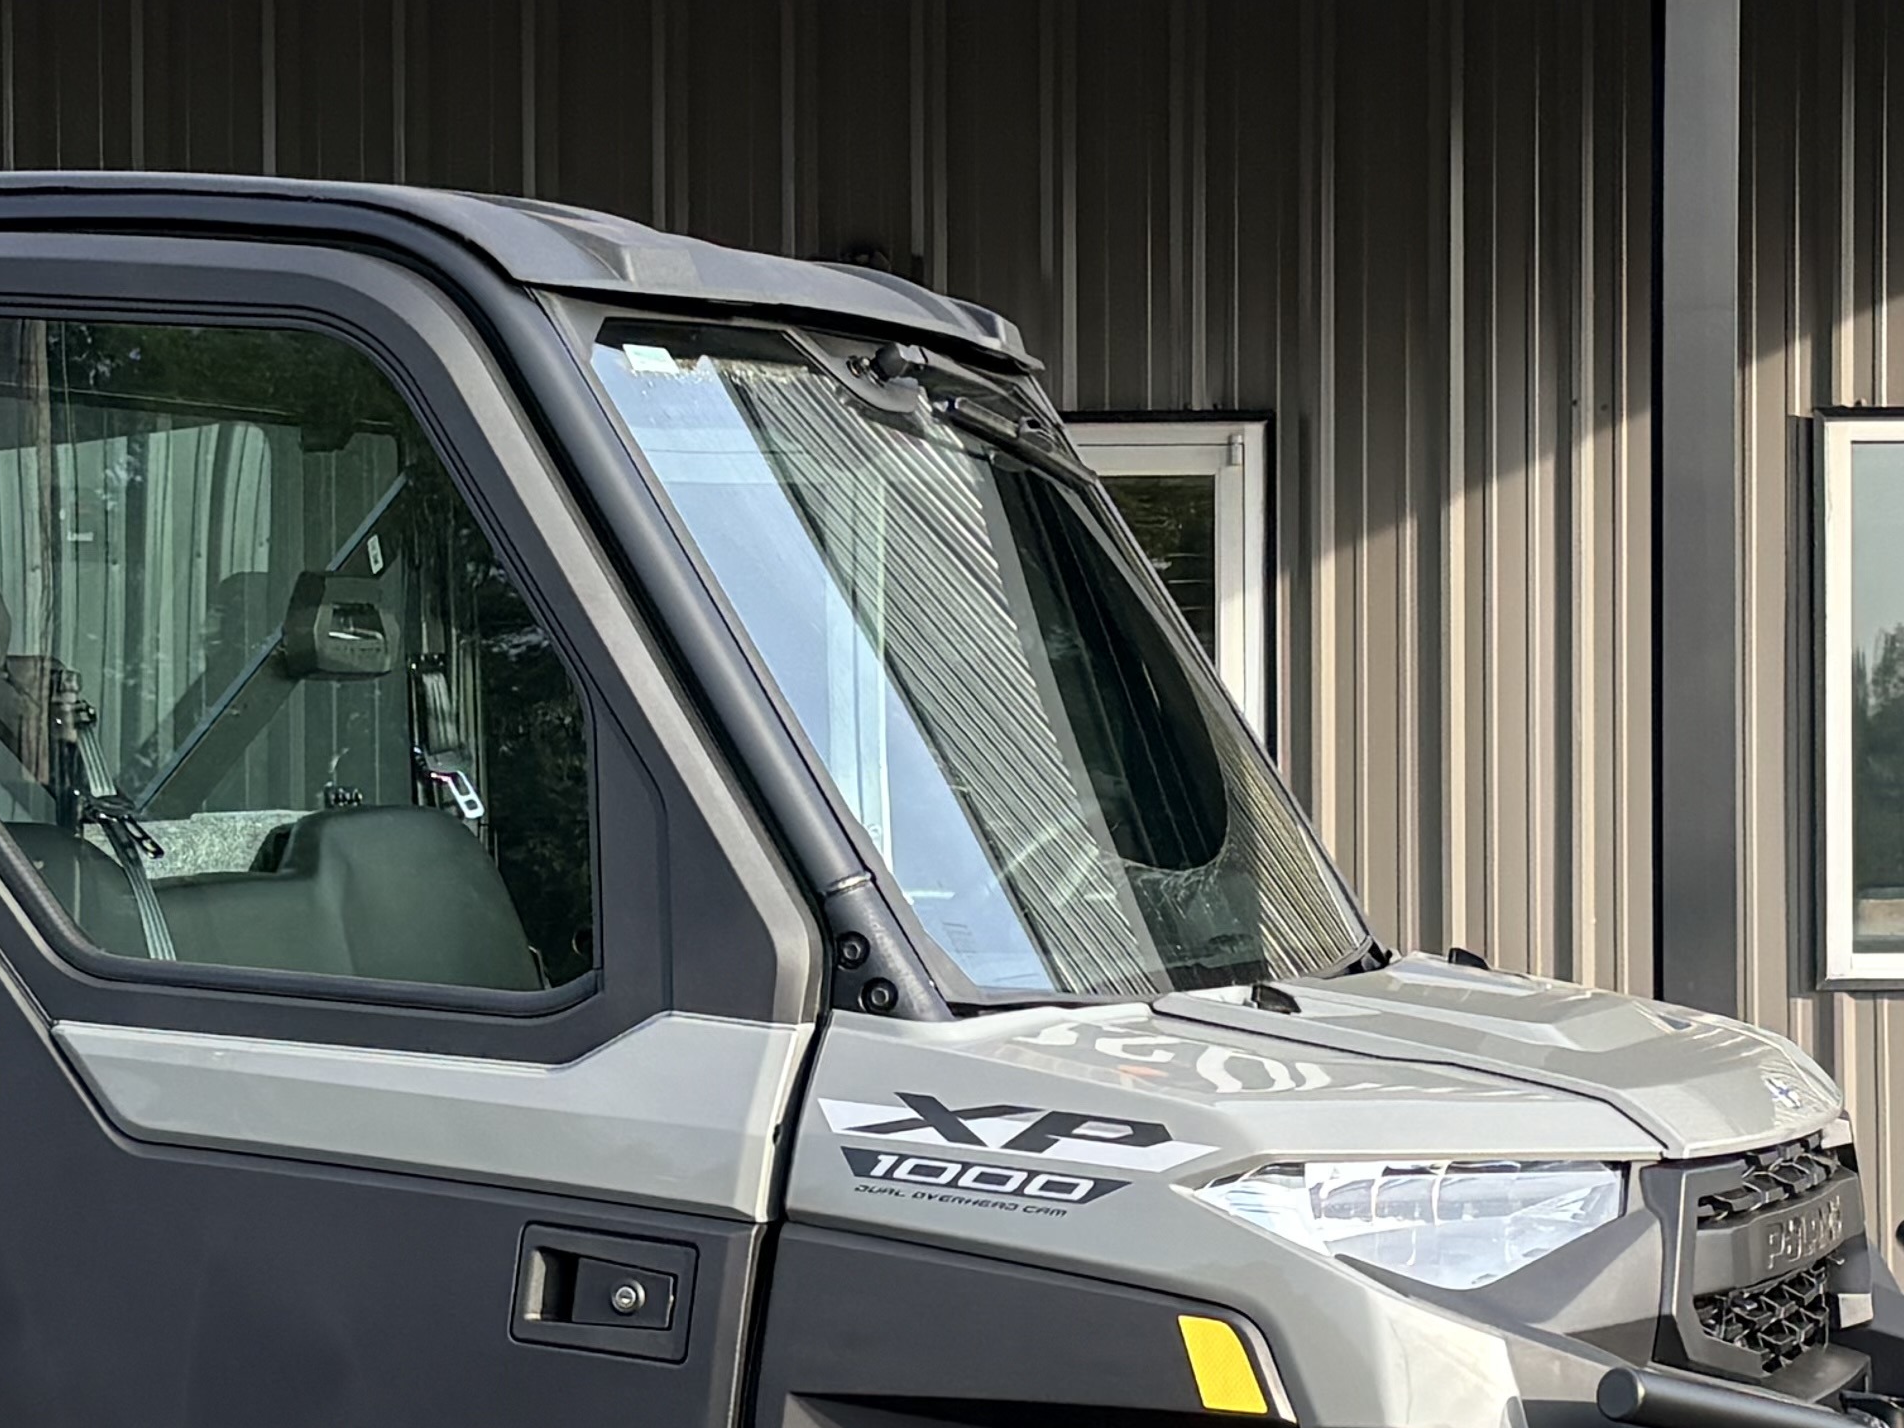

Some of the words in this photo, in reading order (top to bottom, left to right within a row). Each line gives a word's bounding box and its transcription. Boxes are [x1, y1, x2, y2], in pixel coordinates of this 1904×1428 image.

[842, 1091, 1174, 1154] XP
[854, 1184, 906, 1198] DUAL
[911, 1191, 1019, 1211] OVERHEAD
[1022, 1204, 1068, 1218] CAM
[868, 1154, 1095, 1201] 1000
